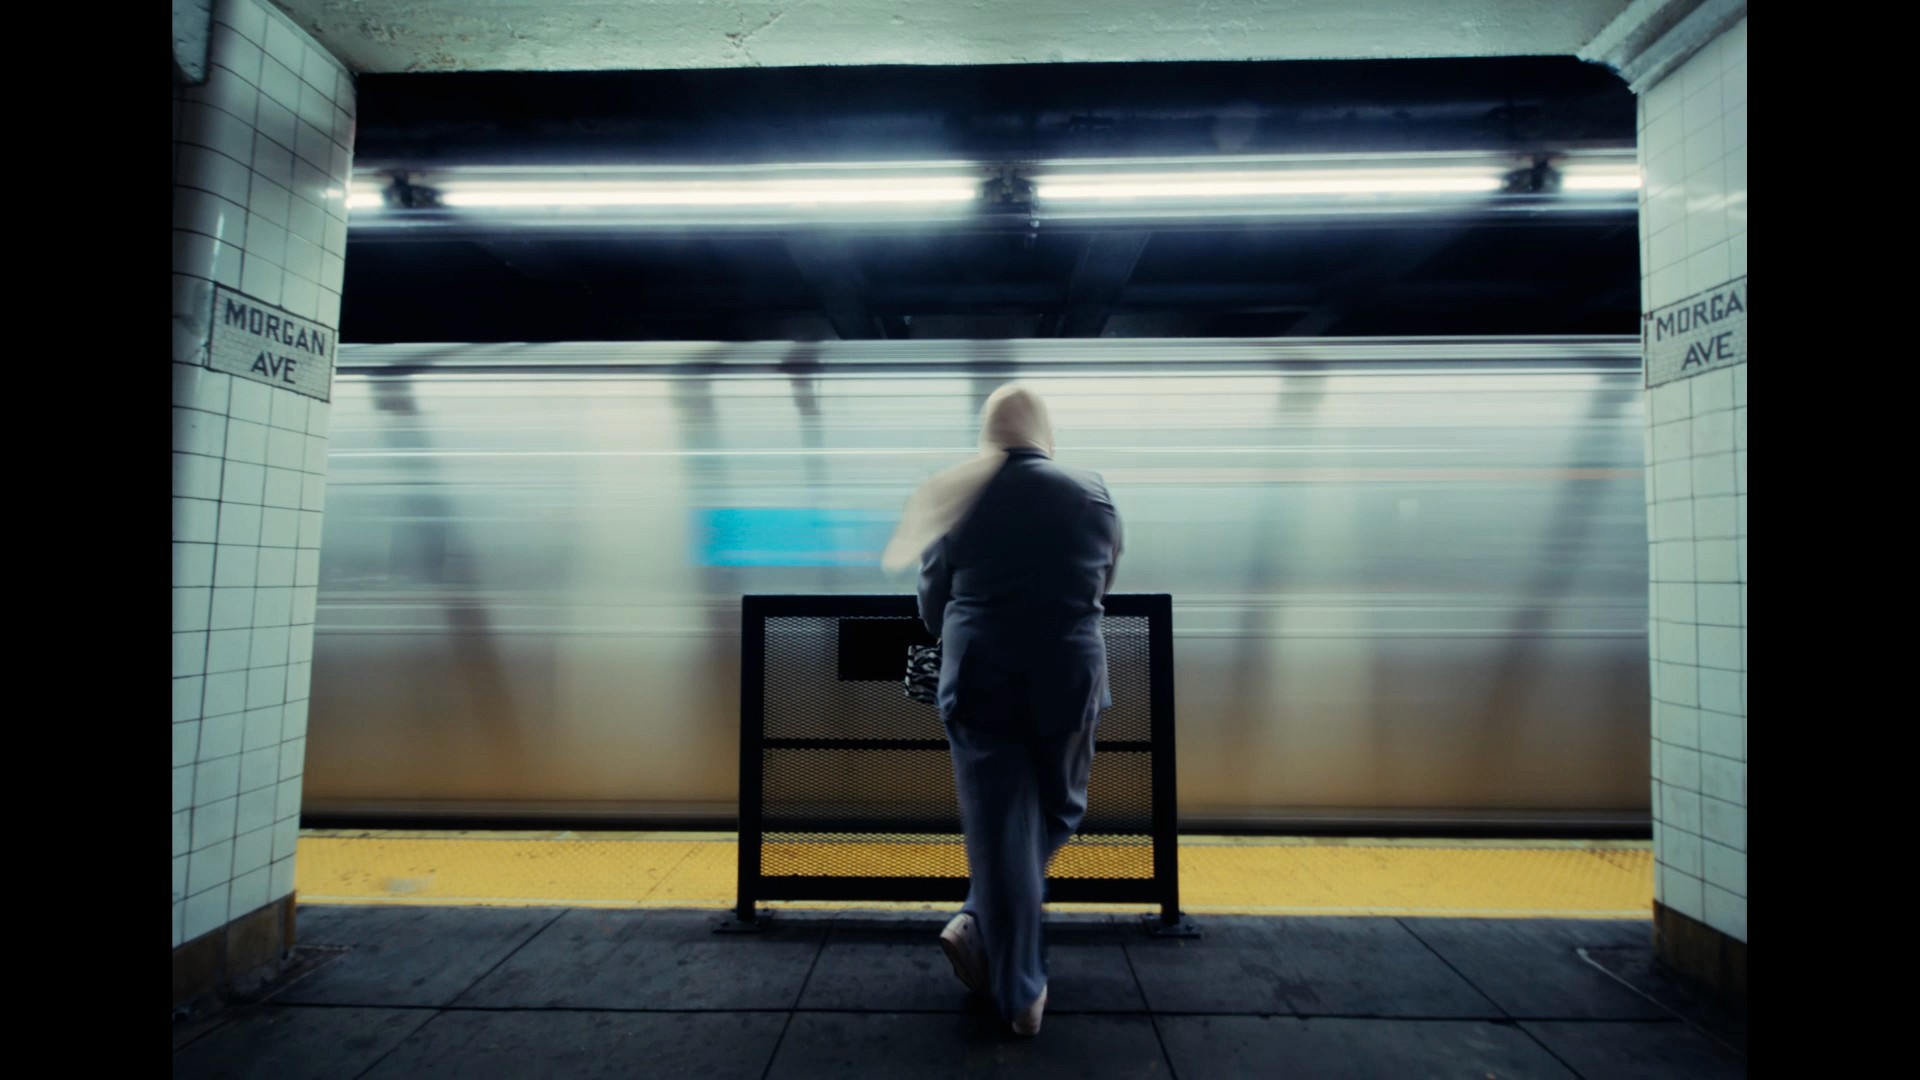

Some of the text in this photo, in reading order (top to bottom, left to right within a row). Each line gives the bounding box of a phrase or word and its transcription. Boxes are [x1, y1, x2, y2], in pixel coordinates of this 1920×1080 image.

[225, 298, 325, 356] MORGAN
[1656, 284, 1747, 341] MORGA
[251, 351, 296, 384] AVE
[1681, 331, 1734, 371] AVE
